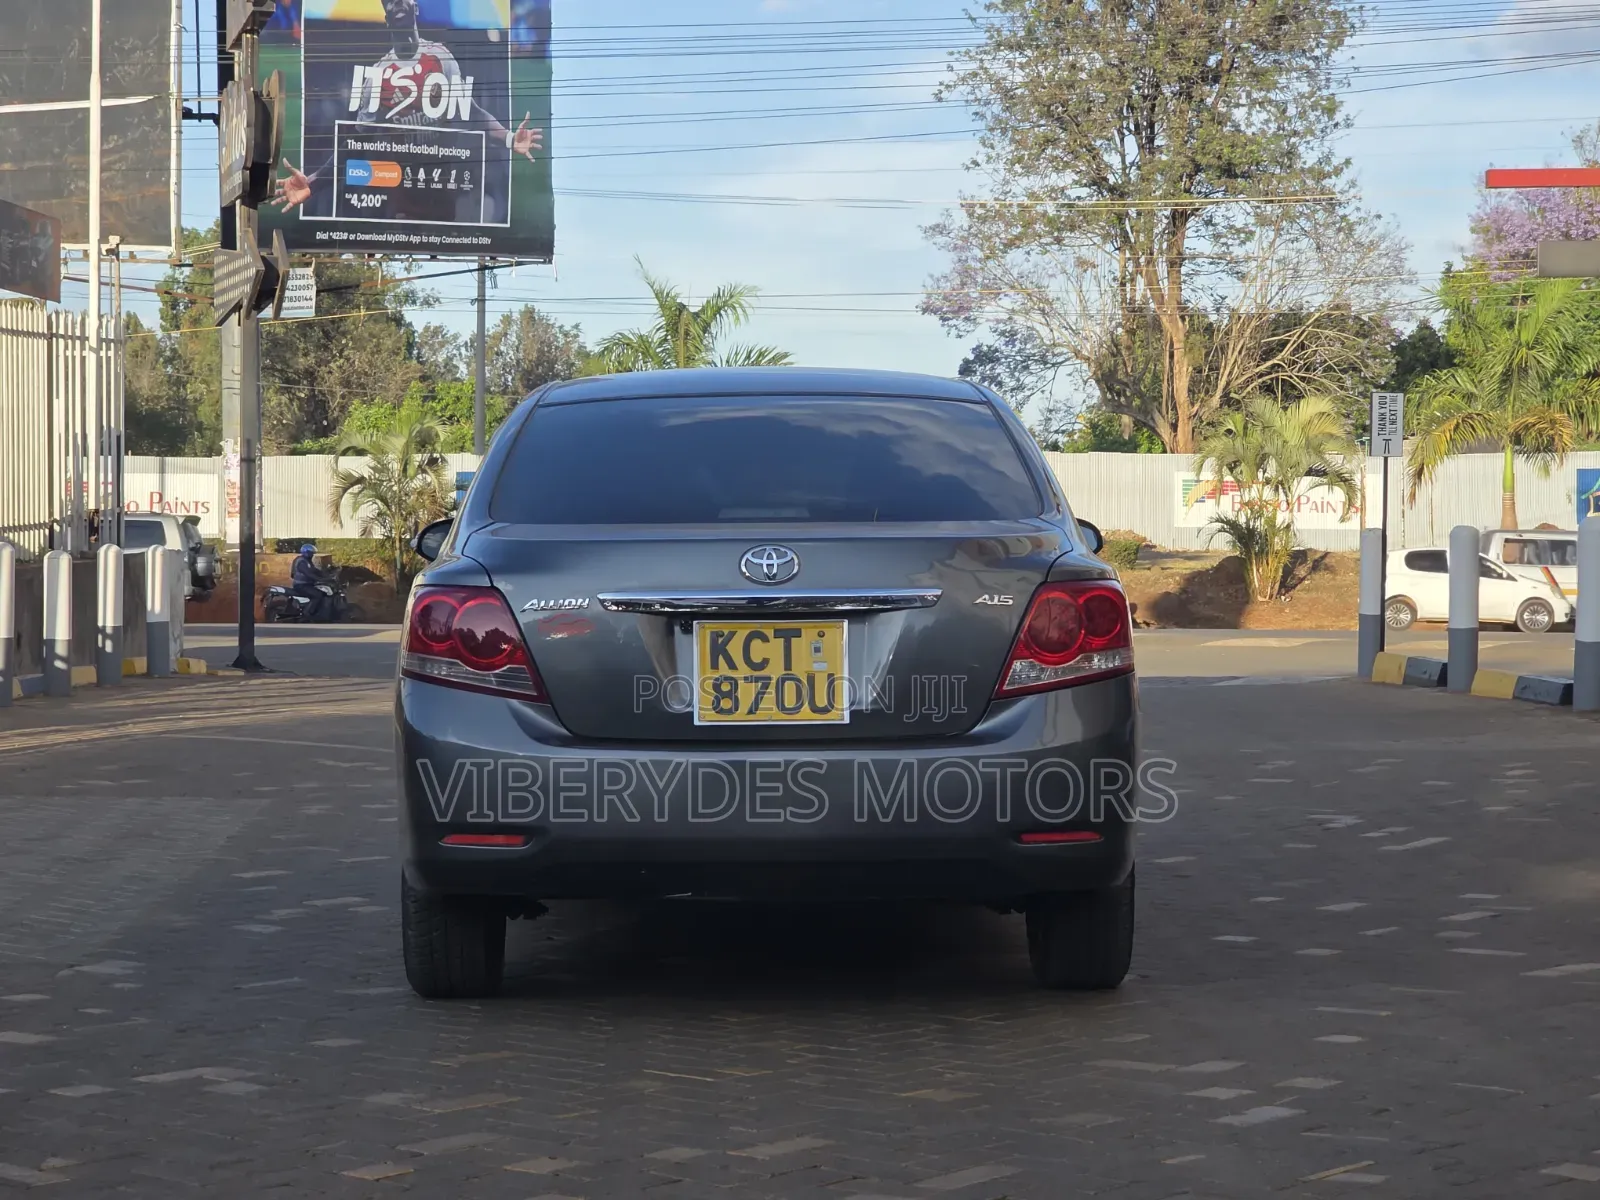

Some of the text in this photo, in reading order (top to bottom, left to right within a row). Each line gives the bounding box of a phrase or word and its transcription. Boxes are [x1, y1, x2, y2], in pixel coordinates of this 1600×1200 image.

[422, 72, 474, 121] ON
[347, 139, 471, 160] The world's best football package
[350, 193, 381, 209] 4,200
[316, 231, 329, 240] Dial
[356, 232, 386, 241] Download
[409, 234, 421, 245] App
[422, 235, 428, 243] to
[429, 235, 441, 245] stay
[441, 236, 472, 245] Connected
[472, 236, 478, 244] to
[478, 236, 492, 245] DStv
[1378, 395, 1388, 436] THANK YOU
[1388, 394, 1398, 436] TILL NEXT TIME
[520, 597, 591, 612] ALLION
[973, 594, 1014, 605] A15
[709, 628, 802, 671] KCT
[710, 673, 836, 716] 870U
